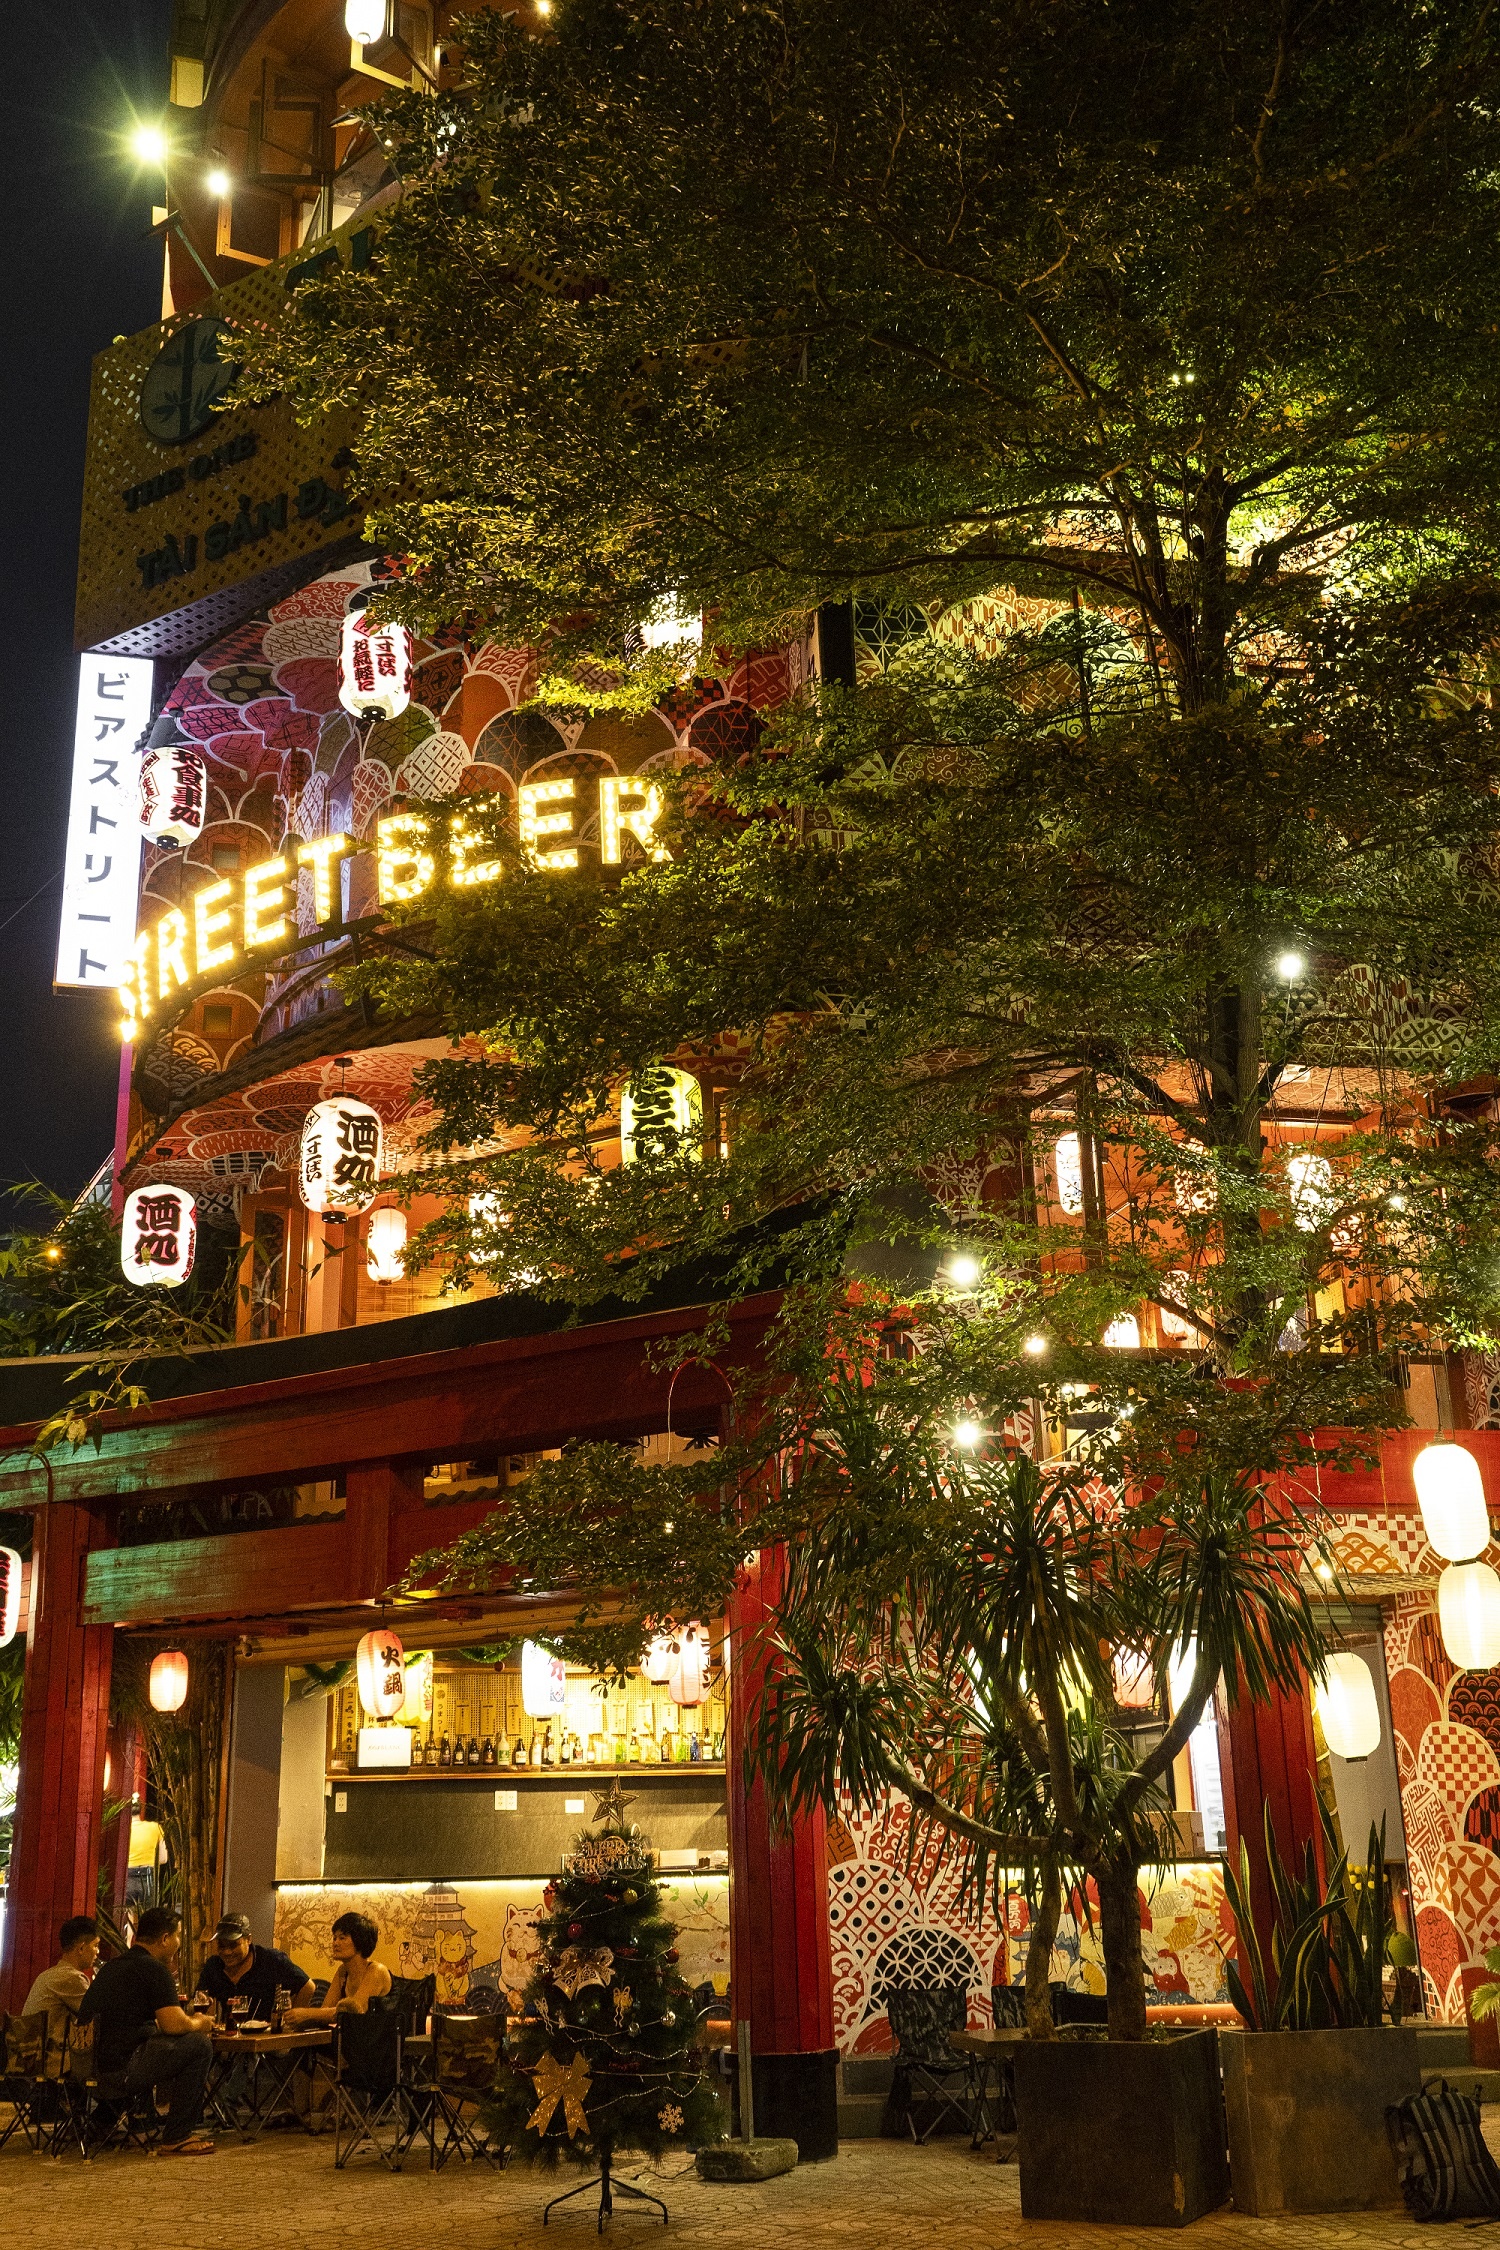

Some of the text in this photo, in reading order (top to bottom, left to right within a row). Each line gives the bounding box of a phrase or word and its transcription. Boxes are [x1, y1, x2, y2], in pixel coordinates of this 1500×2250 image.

[77, 672, 131, 979] ビアストリート
[377, 776, 674, 907] BEER
[381, 1645, 403, 1695] 火鍋
